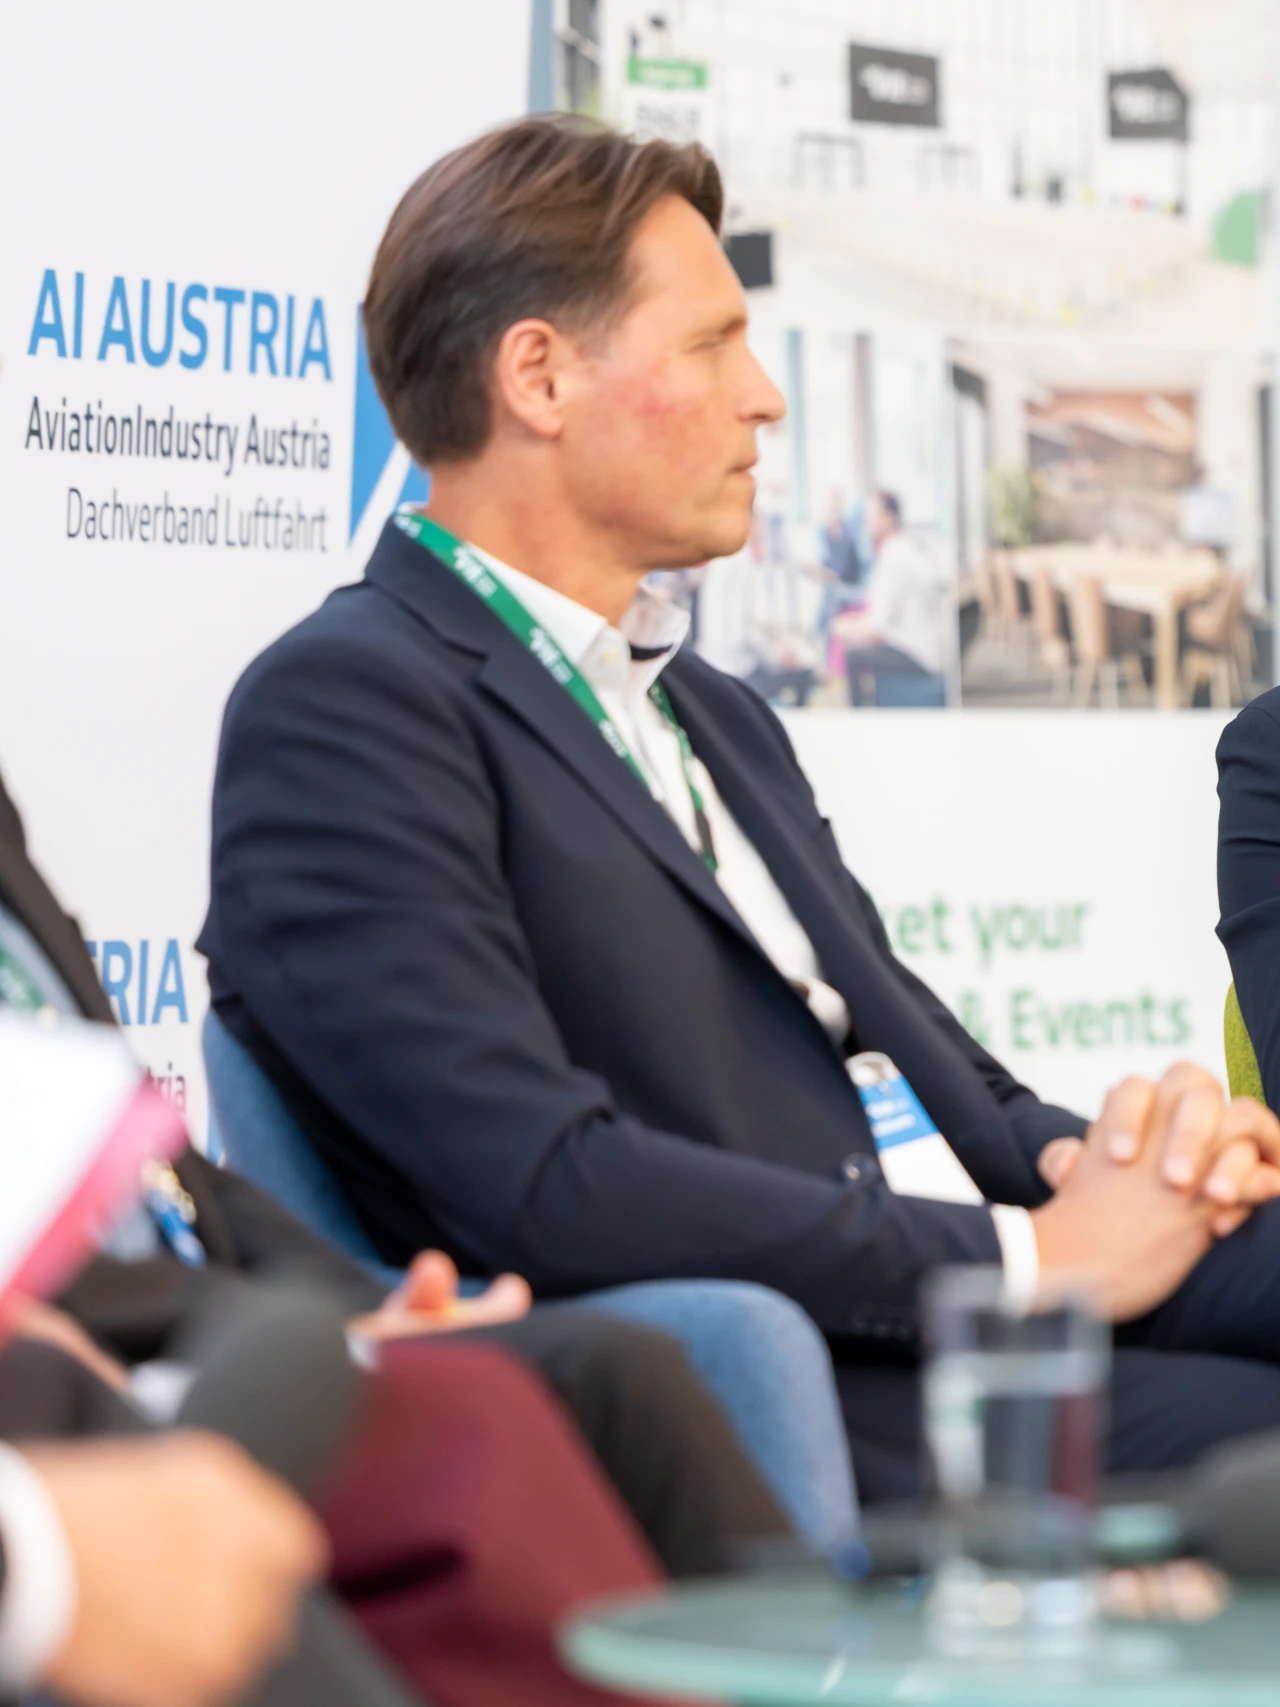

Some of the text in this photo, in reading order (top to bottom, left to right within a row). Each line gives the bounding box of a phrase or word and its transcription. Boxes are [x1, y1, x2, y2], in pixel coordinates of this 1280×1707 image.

[27, 268, 333, 382] AI AUSTRIA
[25, 396, 331, 477] AviationIndustry Austria
[66, 487, 219, 546] Dachverband
[225, 497, 328, 553] Luftfahrt
[889, 896, 1089, 968] et your
[1009, 989, 1191, 1050] Events
